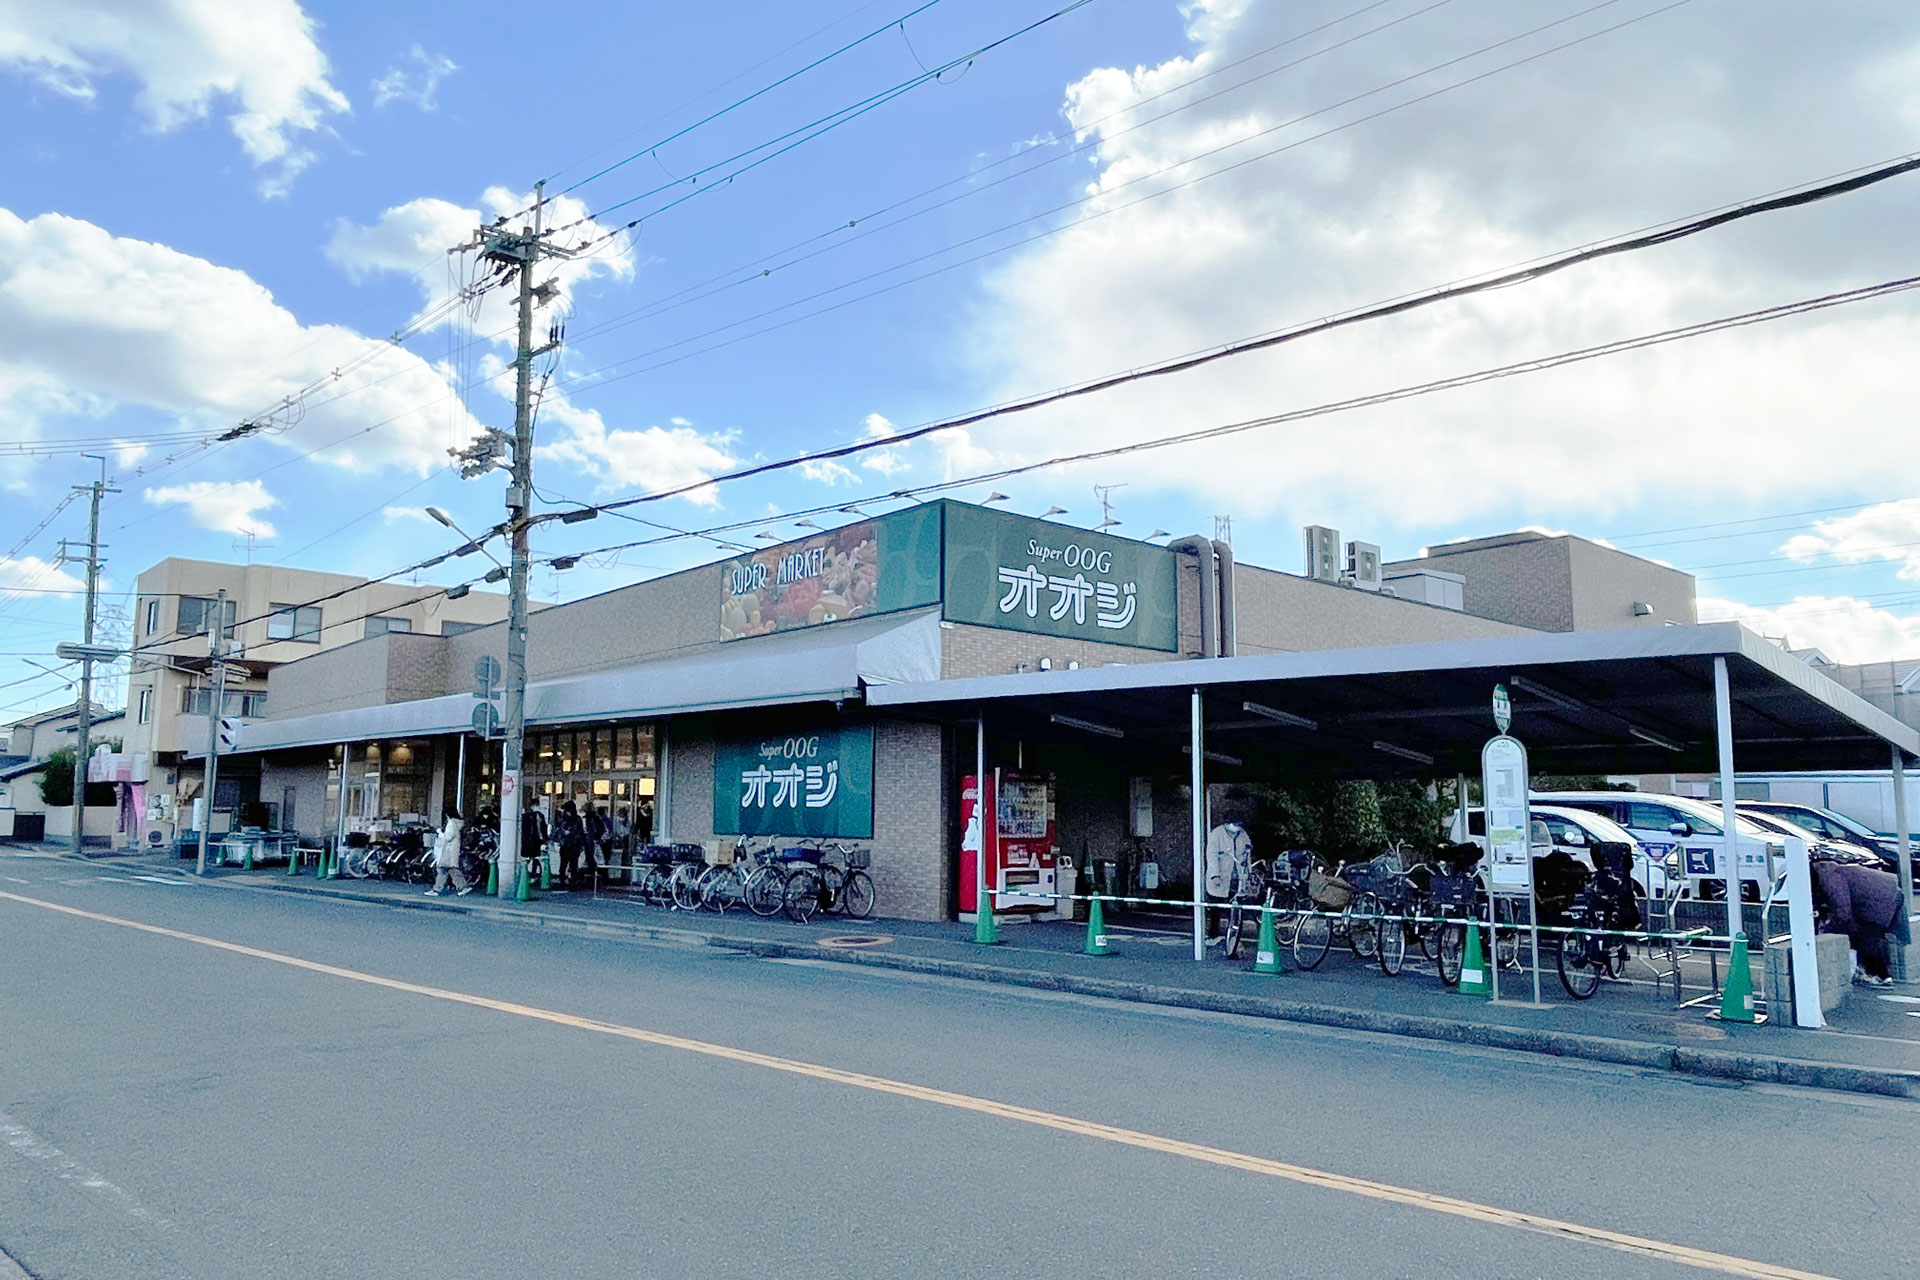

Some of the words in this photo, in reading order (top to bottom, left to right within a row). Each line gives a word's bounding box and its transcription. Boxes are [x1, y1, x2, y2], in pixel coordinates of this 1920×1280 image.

[731, 562, 766, 595] SUPER
[776, 546, 825, 585] MARKET
[1027, 539, 1062, 563] Super
[1063, 544, 1112, 573] OOG
[998, 564, 1137, 630] オオジ
[741, 759, 838, 808] オオジ
